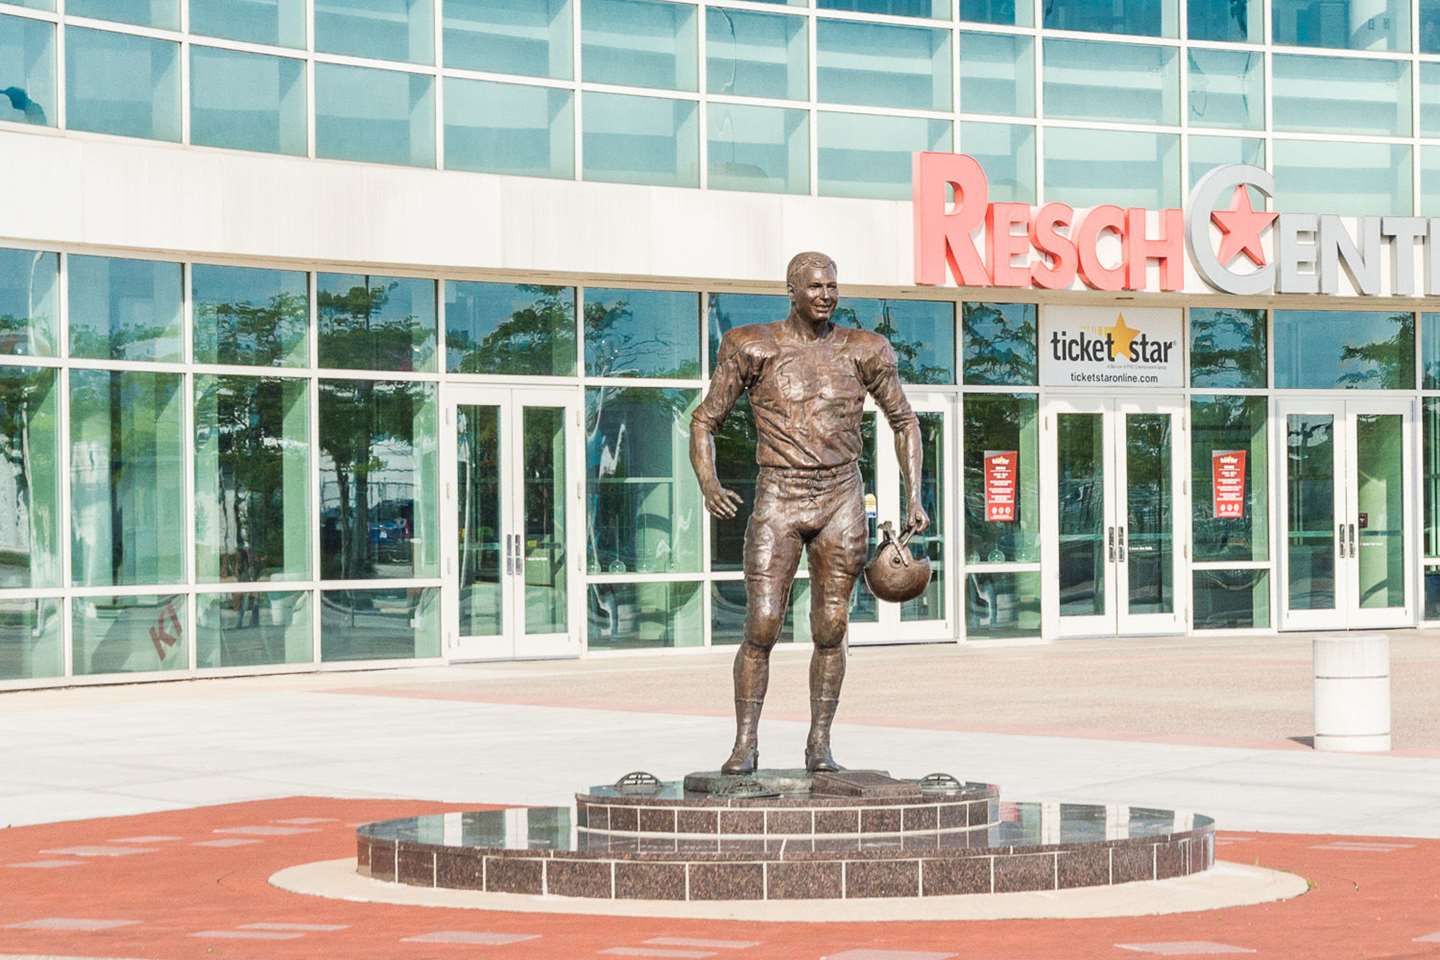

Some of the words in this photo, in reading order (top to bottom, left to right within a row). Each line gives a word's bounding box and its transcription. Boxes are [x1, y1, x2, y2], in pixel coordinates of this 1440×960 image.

[912, 151, 1184, 291] RESCH
[1050, 331, 1115, 362] ticket
[1129, 333, 1173, 363] star
[1070, 372, 1159, 383] ticketstaronline.com
